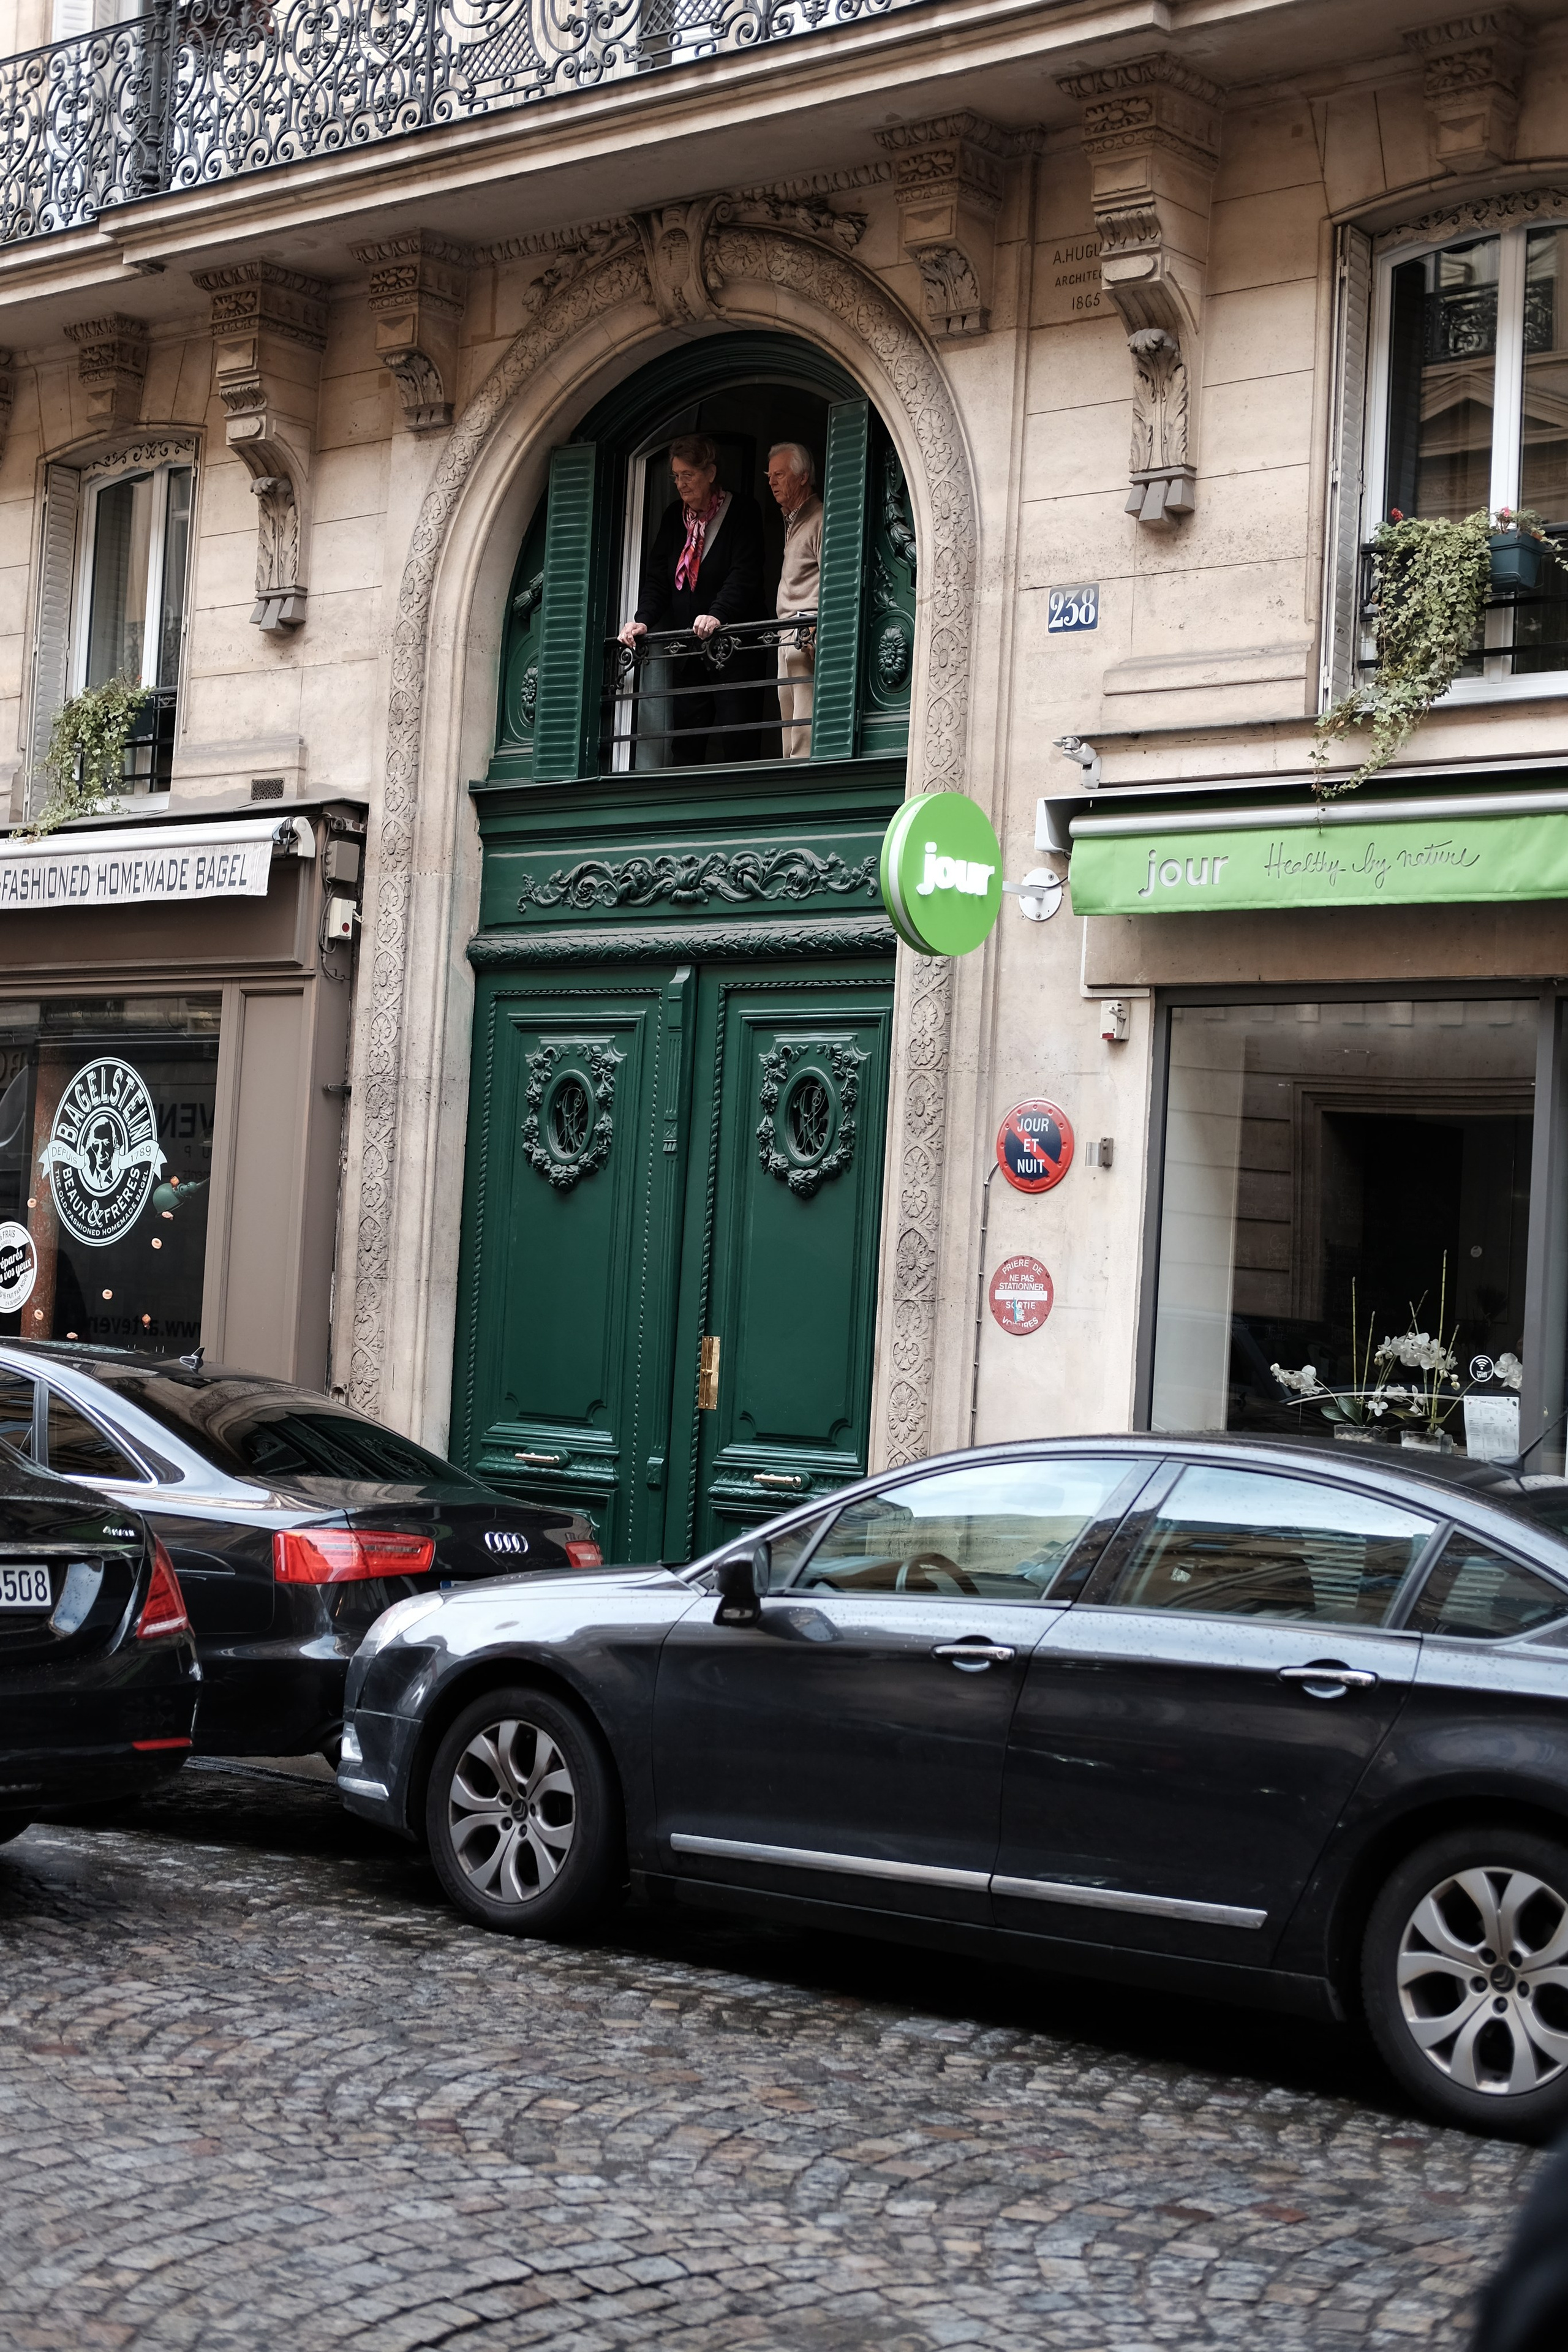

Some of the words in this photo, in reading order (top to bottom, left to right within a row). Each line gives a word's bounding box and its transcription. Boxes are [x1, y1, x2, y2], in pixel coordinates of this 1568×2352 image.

[1072, 292, 1101, 311] 1865
[1049, 588, 1096, 629] 238
[97, 858, 189, 896] HOMEMADE
[195, 854, 247, 891] BAGEL
[916, 842, 995, 896] jour
[1137, 849, 1229, 897] jour
[1264, 842, 1346, 886] Healthy
[1352, 842, 1392, 889] by
[1397, 840, 1480, 868] nature
[56, 1066, 152, 1145] BAGELSTEIN
[1017, 1118, 1049, 1133] JOUR
[51, 1147, 78, 1164] DEPUIS
[130, 1145, 151, 1162] 1789
[1023, 1138, 1039, 1153] ET
[1017, 1158, 1045, 1174] NUIT
[58, 1190, 101, 1236] OLD-FASHIONED
[102, 1201, 138, 1236] HOMEMADE
[135, 1169, 149, 1202] BAGEL
[62, 1167, 88, 1221] BEAUX
[88, 1199, 104, 1228] &
[104, 1167, 141, 1224] FRÈRES
[4, 1267, 15, 1281] vos
[15, 1257, 32, 1277] yeux
[1001, 1259, 1030, 1275] PRIERE
[1032, 1263, 1044, 1276] DE
[999, 1282, 1044, 1291] STATIONNER
[1002, 1316, 1039, 1328] VORES
[0, 1570, 47, 1602] 508
